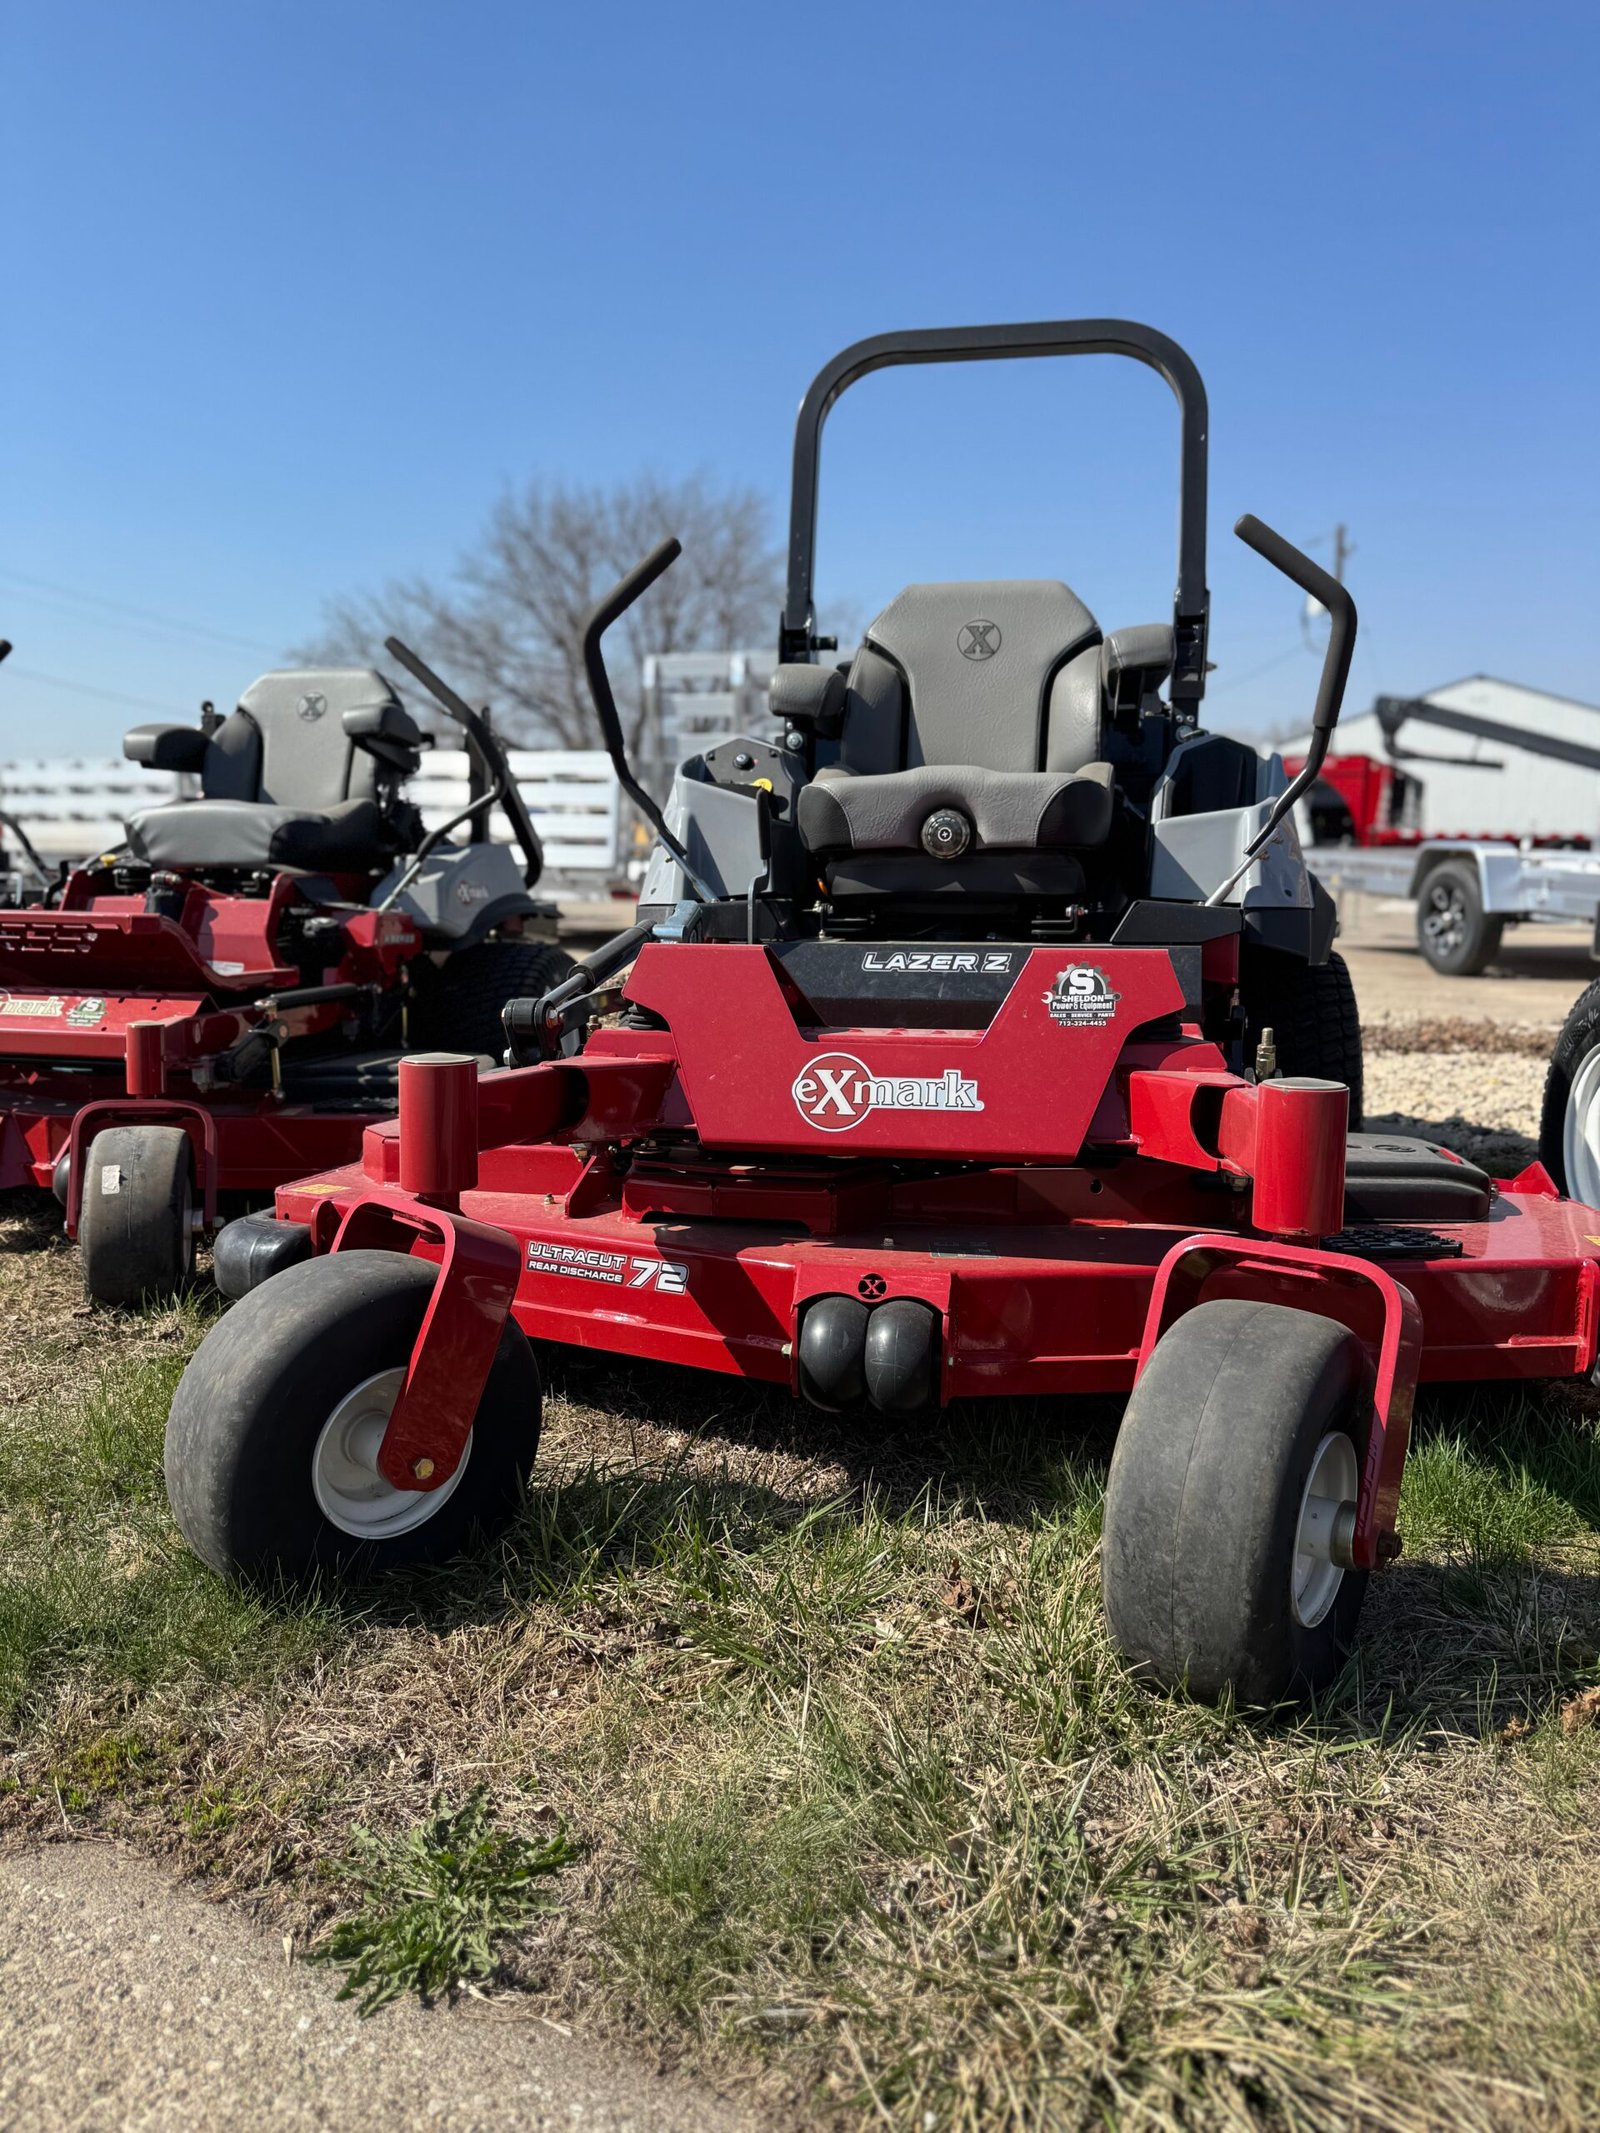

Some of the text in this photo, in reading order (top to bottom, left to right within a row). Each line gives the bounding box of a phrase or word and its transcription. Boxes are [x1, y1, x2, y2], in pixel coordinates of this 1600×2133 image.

[962, 623, 997, 656] X
[862, 952, 1012, 972] LAZER Z
[1069, 968, 1095, 995] S
[0, 996, 61, 1015] mark
[1052, 1002, 1074, 1010] Power
[1080, 1001, 1113, 1011] Equipment
[794, 1067, 977, 1117] eXmark
[528, 1242, 627, 1270] ULTRACUT
[528, 1260, 623, 1283] REAR DISCHARGE
[628, 1258, 689, 1294] 72
